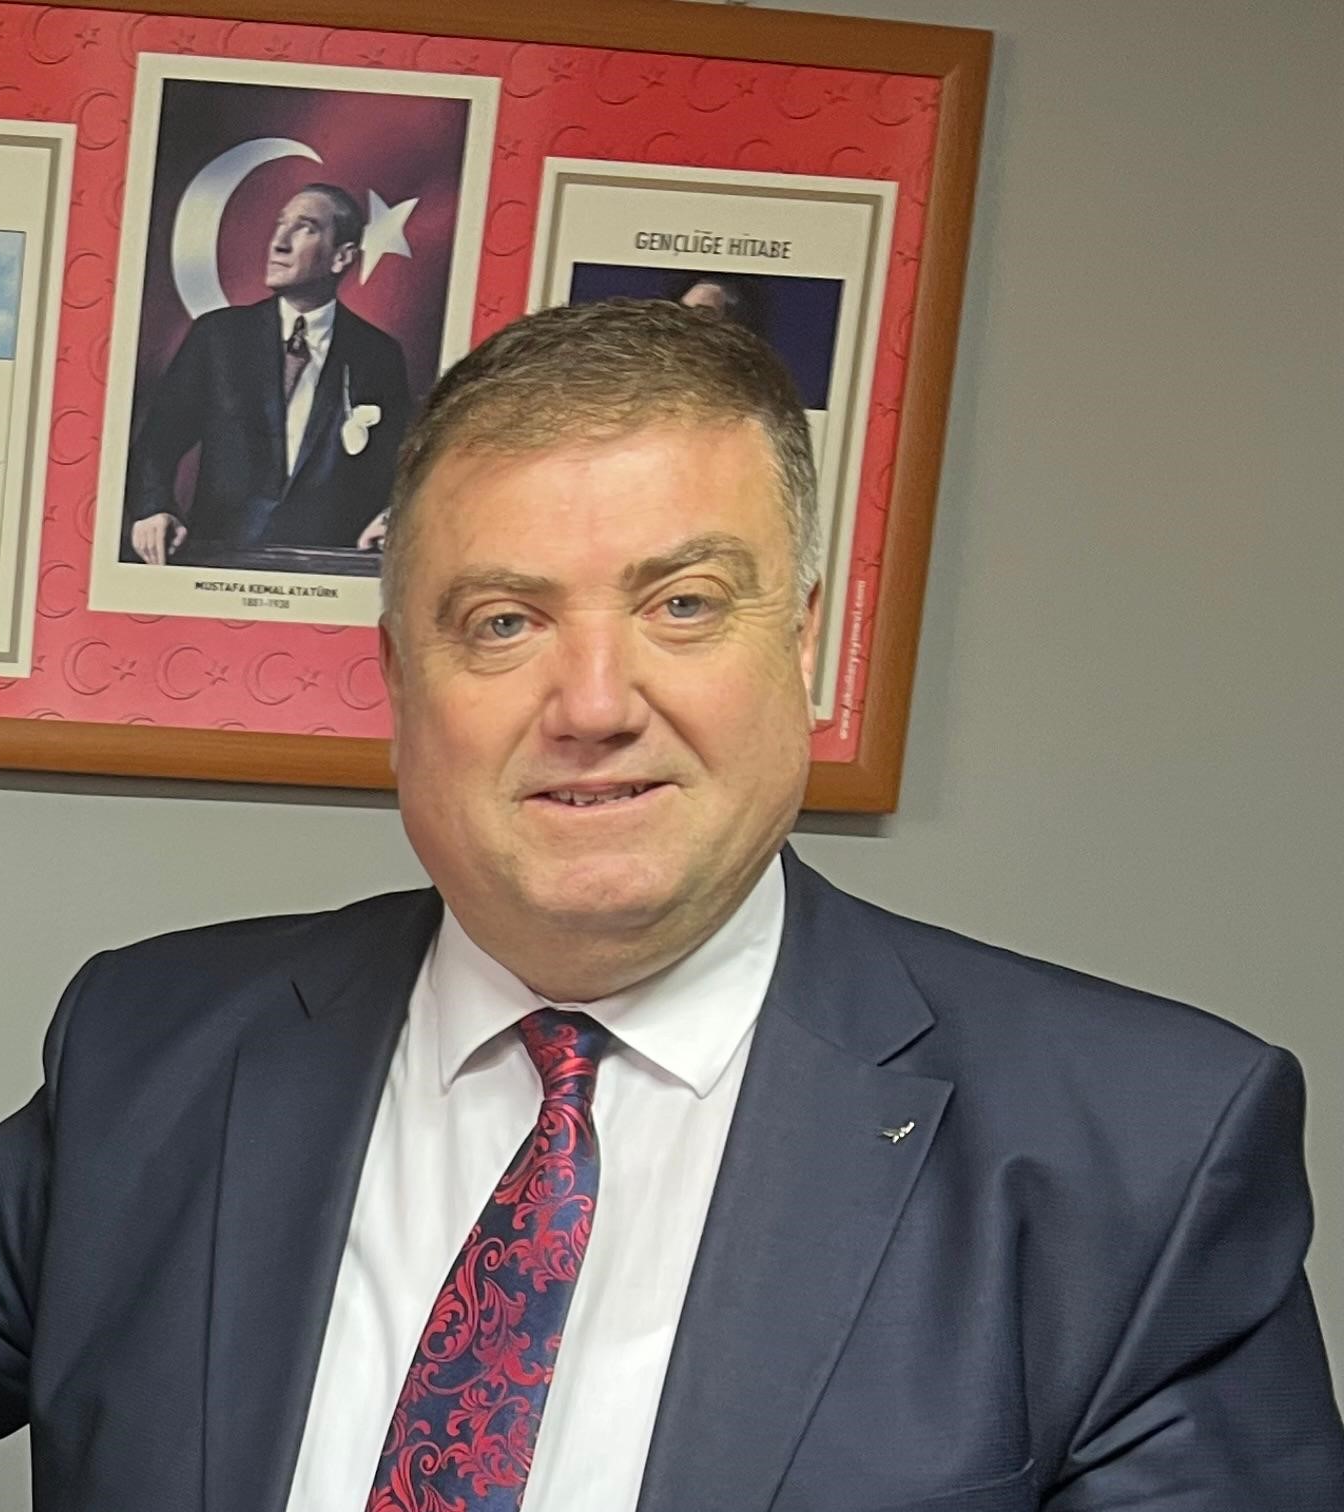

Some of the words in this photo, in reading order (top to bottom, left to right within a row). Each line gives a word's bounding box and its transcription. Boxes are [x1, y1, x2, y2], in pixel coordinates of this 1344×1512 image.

[727, 233, 793, 260] HİTABE
[194, 581, 246, 593] MUSTAFA
[248, 584, 287, 596] KEMAL
[288, 585, 338, 598] ATATÜRK
